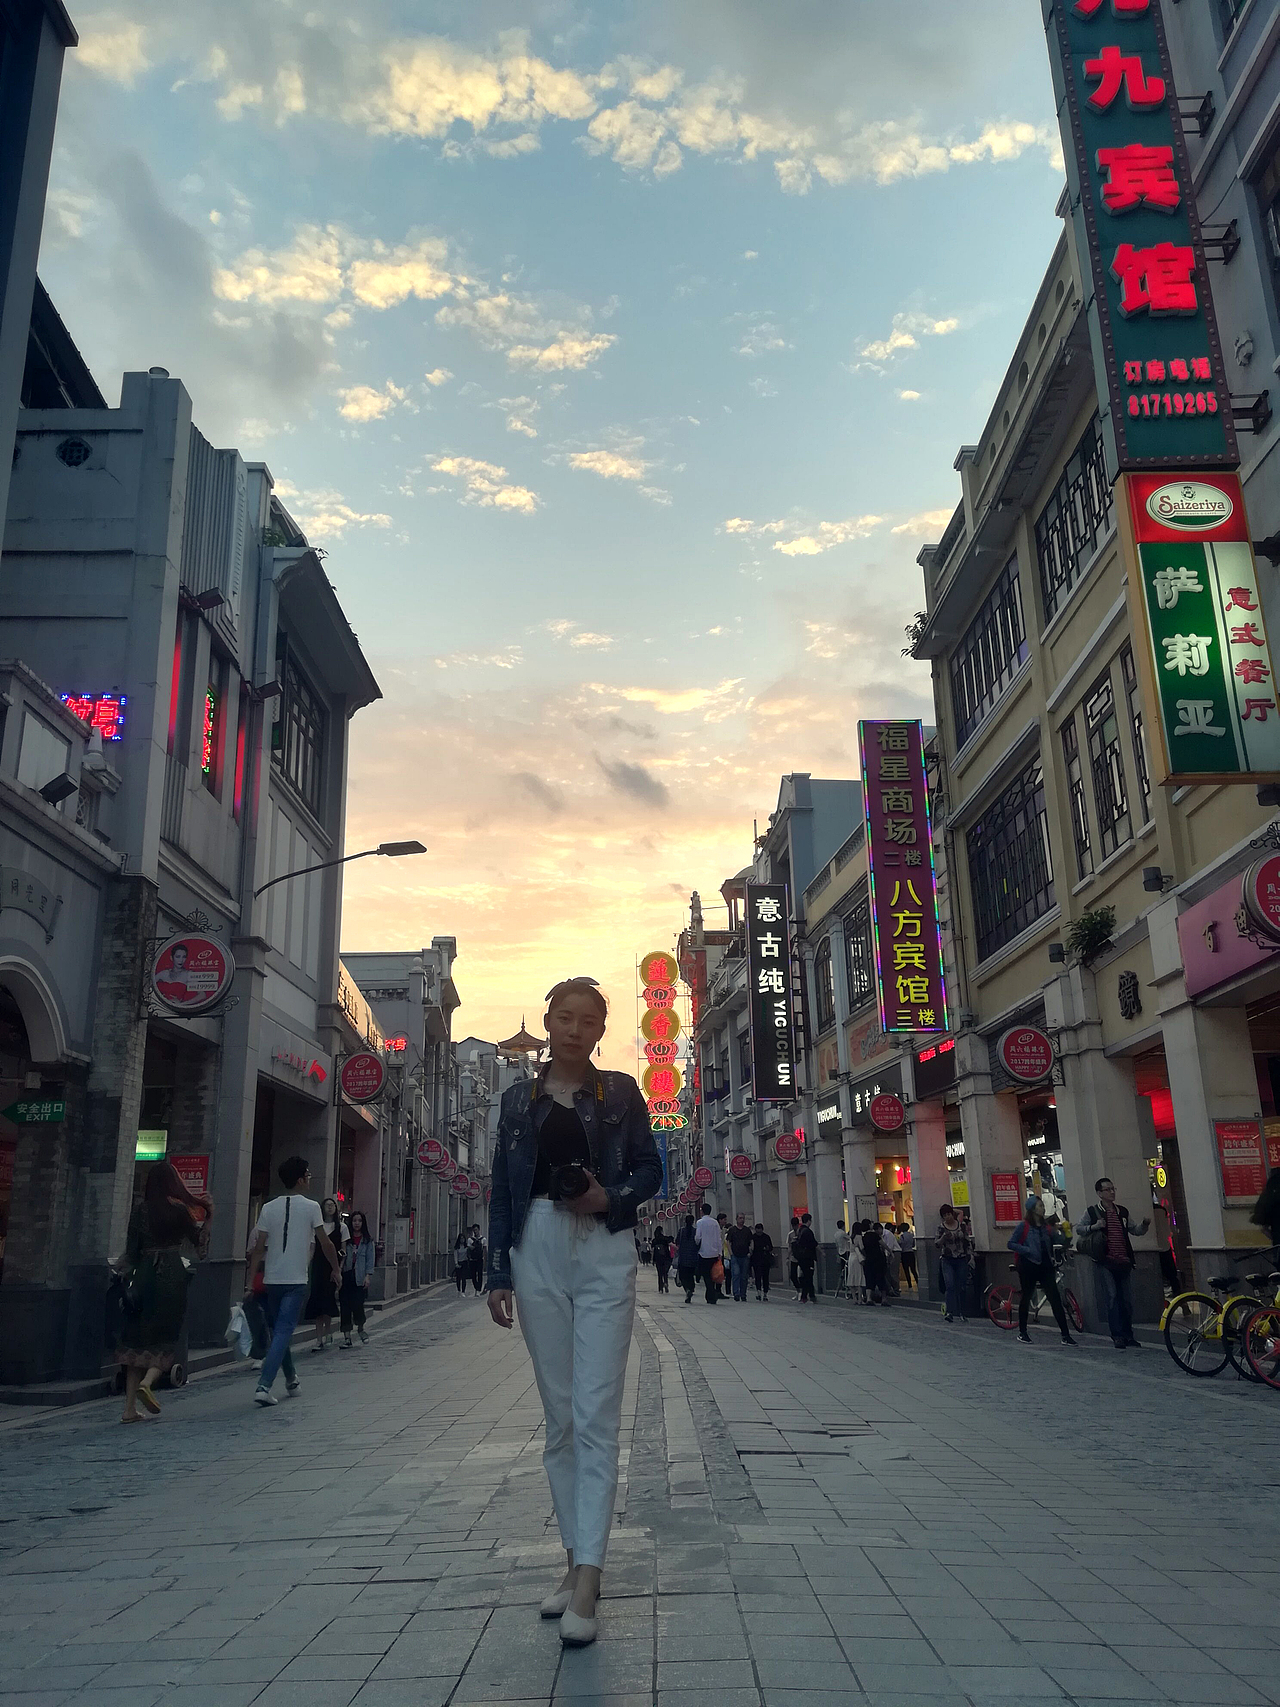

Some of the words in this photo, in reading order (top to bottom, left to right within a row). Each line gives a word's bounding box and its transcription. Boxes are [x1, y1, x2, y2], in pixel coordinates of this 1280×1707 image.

[1123, 357, 1212, 384] 订房电话
[1127, 391, 1218, 417] 81719265
[1159, 495, 1225, 514] Saizeriya
[1153, 566, 1226, 737] 萨莉亚
[1225, 586, 1276, 722] 意式餐厅
[877, 724, 917, 845] 福星商场
[883, 848, 922, 867] 二楼
[755, 896, 786, 995] 意古纯
[890, 879, 930, 1004] 八方宾馆
[648, 957, 675, 1094] 蓮香樓
[896, 1007, 936, 1027] 三楼
[773, 999, 790, 1086] YIGUCHUN
[1010, 1045, 1045, 1053] 周六福珠宝
[17, 1102, 64, 1114] 安全出口
[26, 1113, 51, 1121] EXIT
[1224, 1139, 1256, 1148] 跨年盛典
